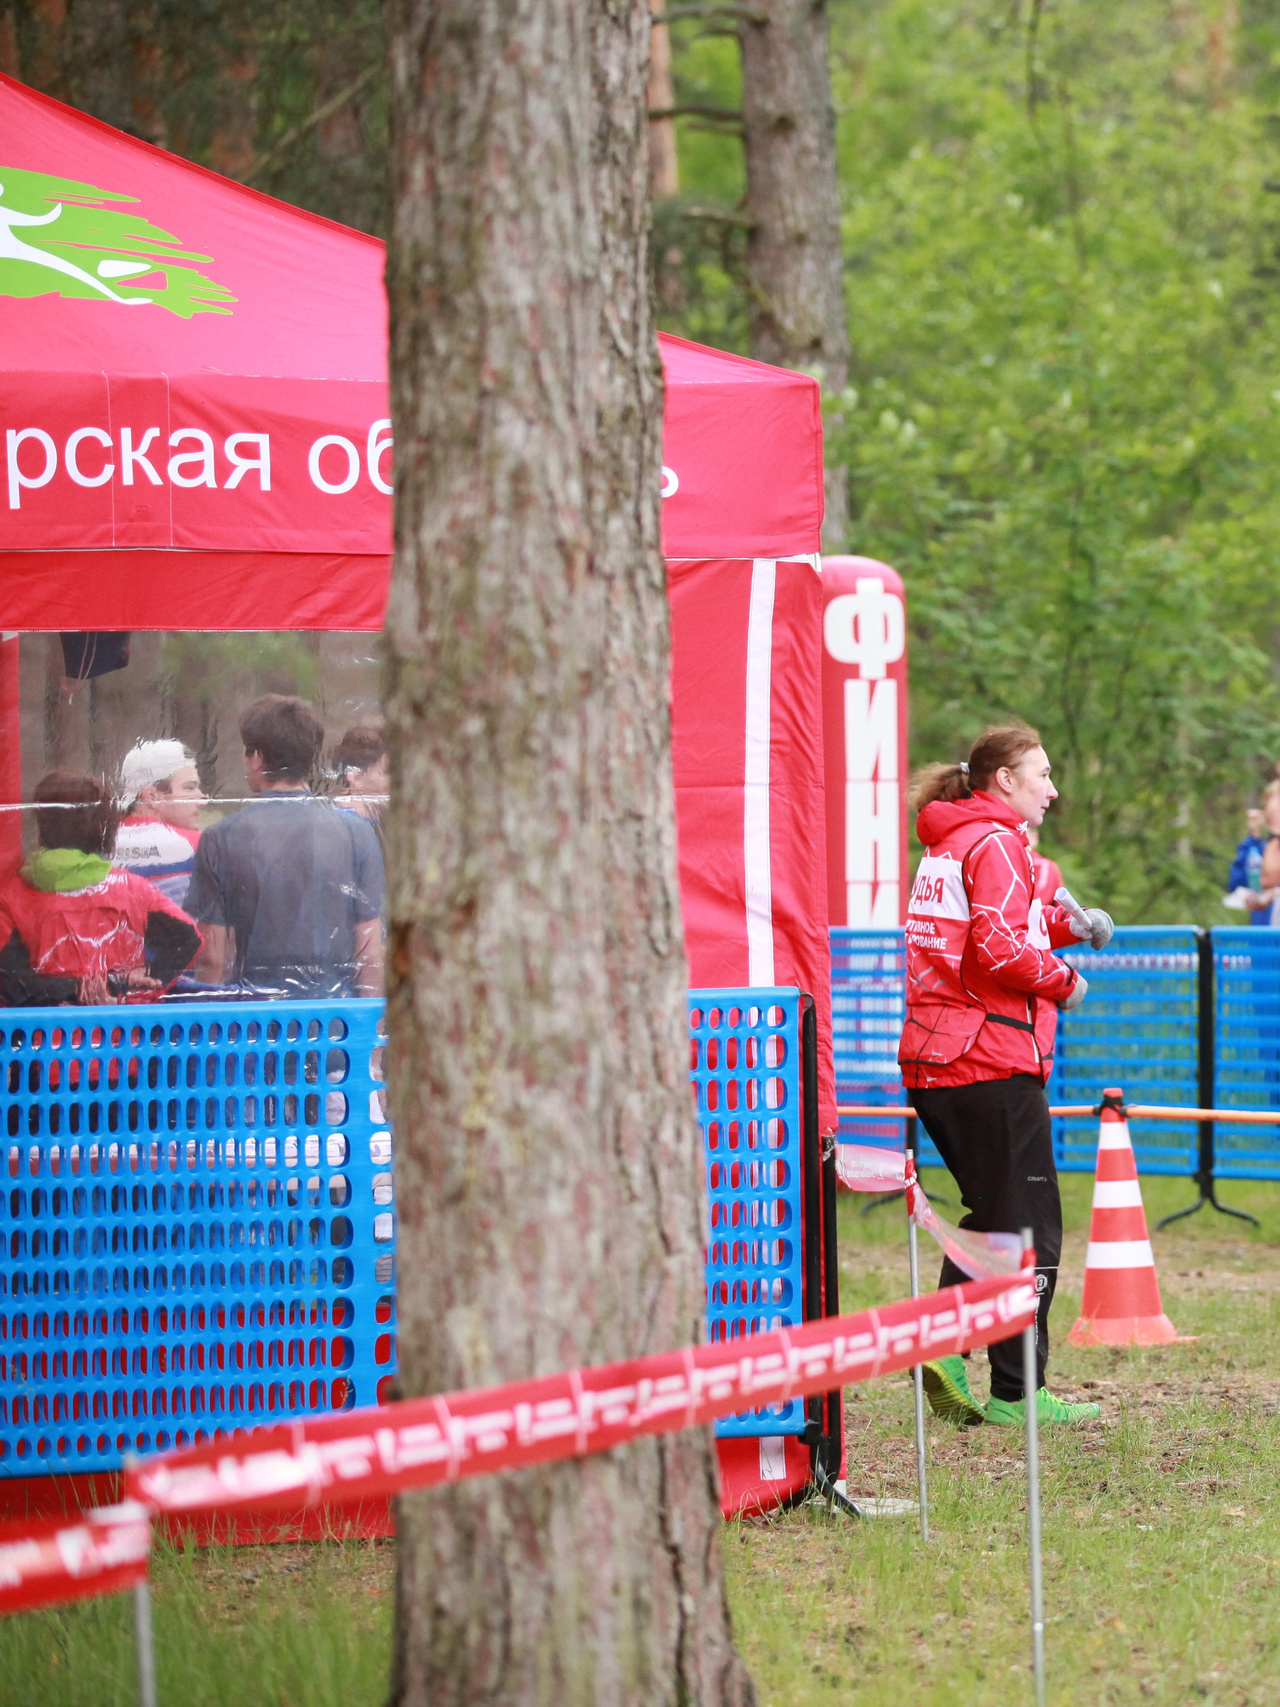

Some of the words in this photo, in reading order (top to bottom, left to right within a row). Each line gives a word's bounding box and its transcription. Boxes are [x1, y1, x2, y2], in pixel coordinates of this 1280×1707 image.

[6, 427, 271, 510] рская
[911, 875, 944, 905] УДЬЯ
[906, 919, 935, 934] РТИВНОЕ
